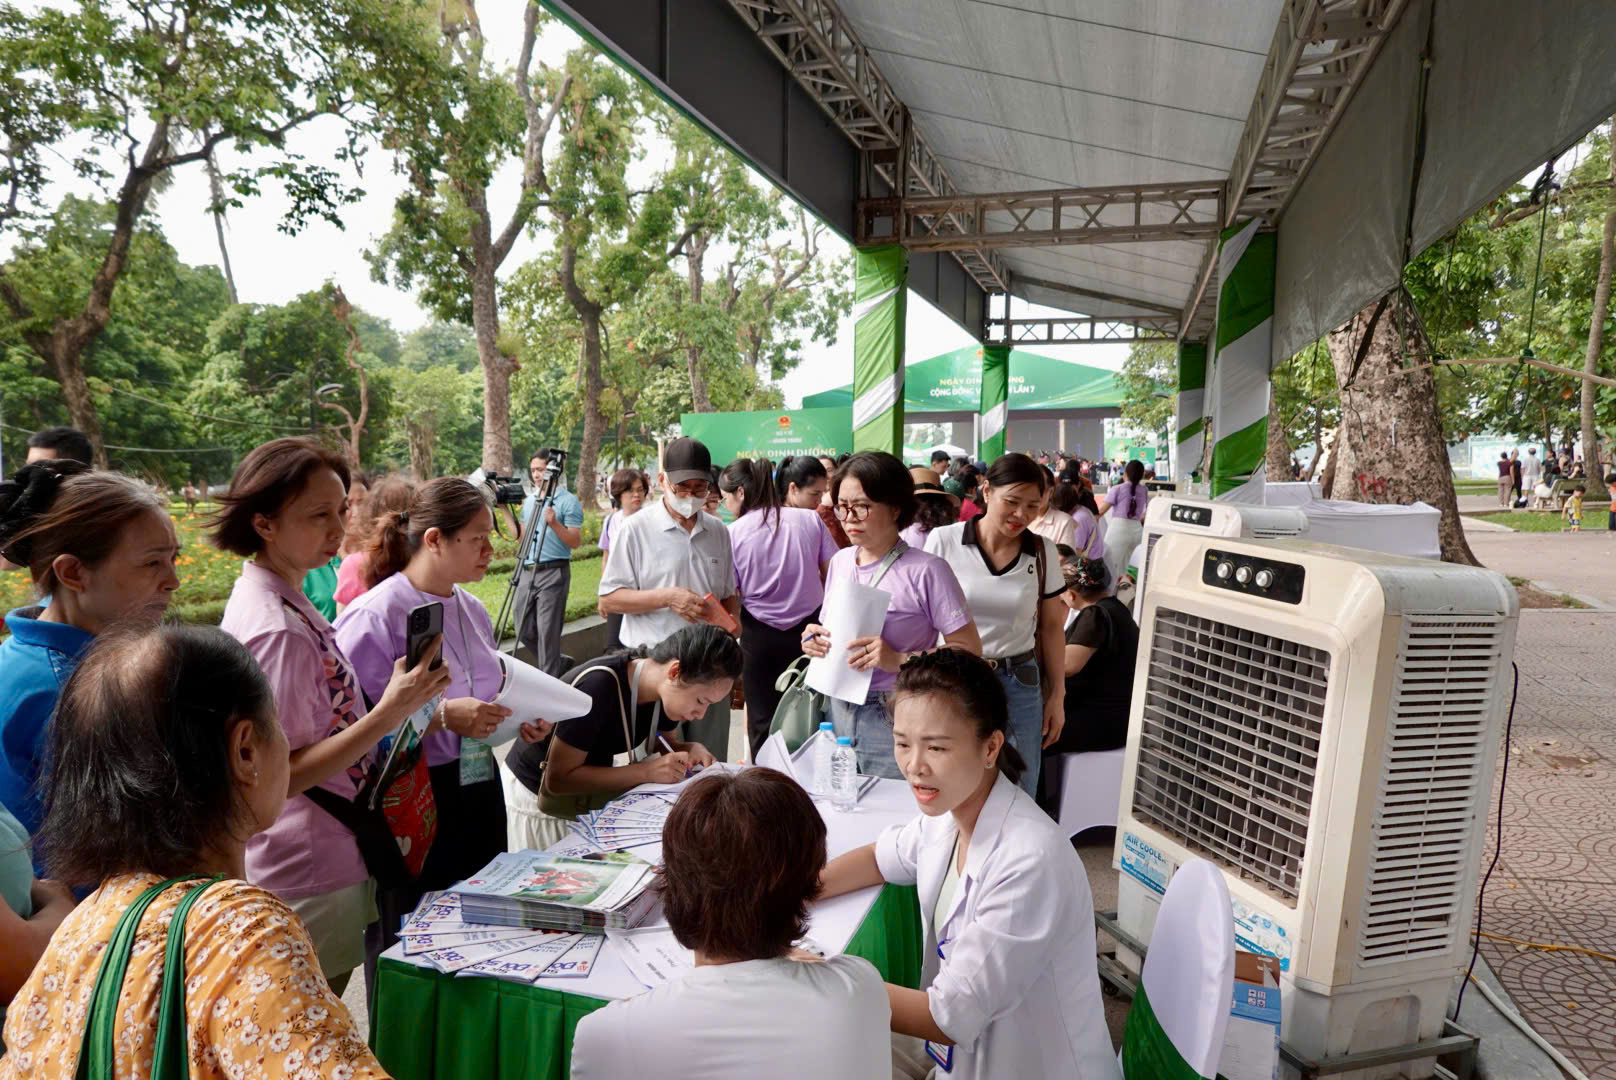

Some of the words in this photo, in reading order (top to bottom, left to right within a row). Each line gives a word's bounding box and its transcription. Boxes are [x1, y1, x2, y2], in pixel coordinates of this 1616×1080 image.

[930, 387, 951, 397] CỘNG
[767, 449, 794, 457] DINH
[796, 445, 836, 457] DƯỠNG
[1028, 564, 1034, 574] C
[1127, 835, 1139, 847] AIR
